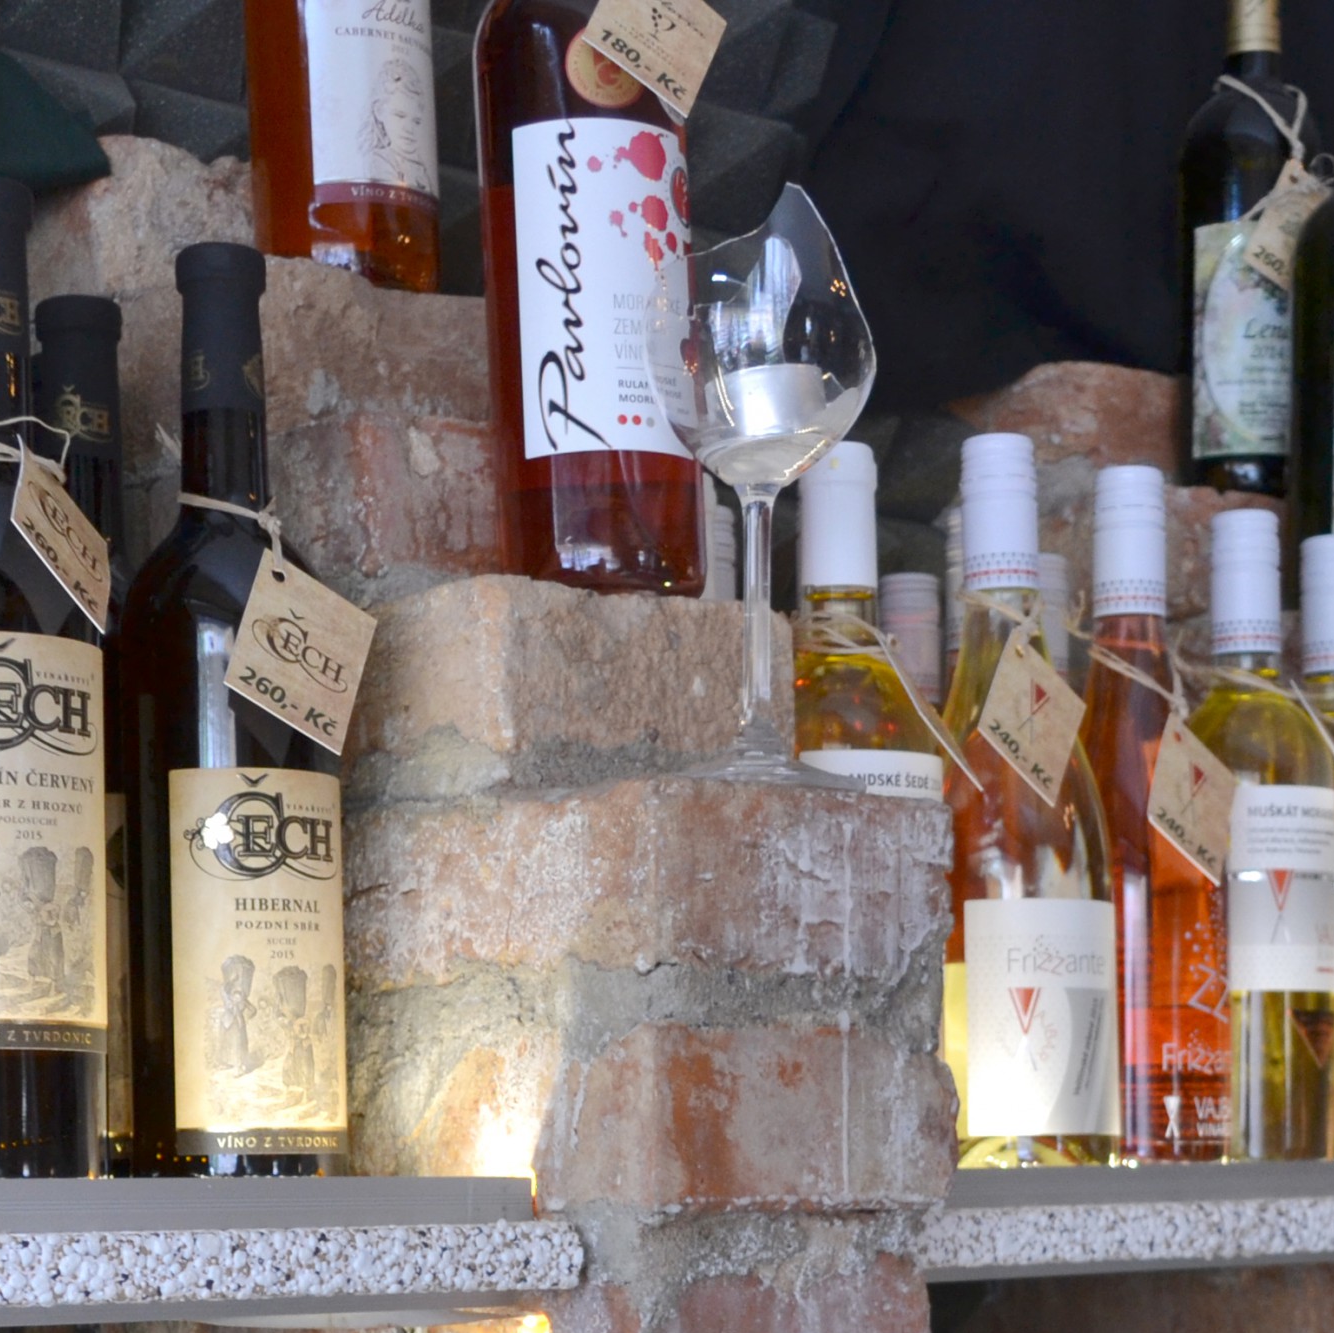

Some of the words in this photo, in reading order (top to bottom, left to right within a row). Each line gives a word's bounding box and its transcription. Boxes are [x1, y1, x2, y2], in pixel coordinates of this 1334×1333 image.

[238, 666, 300, 713] 260,-
[302, 706, 338, 738] Kč
[24, 767, 96, 795] ČERVENÝ
[905, 772, 929, 789] ŠEDÉ
[17, 799, 27, 810] Z
[33, 798, 84, 815] HROZNŮ
[15, 829, 44, 841] 2015
[234, 896, 321, 915] HIBERNAL
[235, 916, 289, 931] POZDNÍ
[294, 918, 321, 933] SBĚR
[270, 949, 295, 960] 2015
[1007, 946, 1106, 977] Frizzante
[7, 1029, 18, 1042] Z
[23, 1029, 93, 1045] TVRDONIC
[216, 1134, 257, 1149] VÍNO
[264, 1137, 273, 1148] Z
[279, 1136, 339, 1149] TVRDONIC
